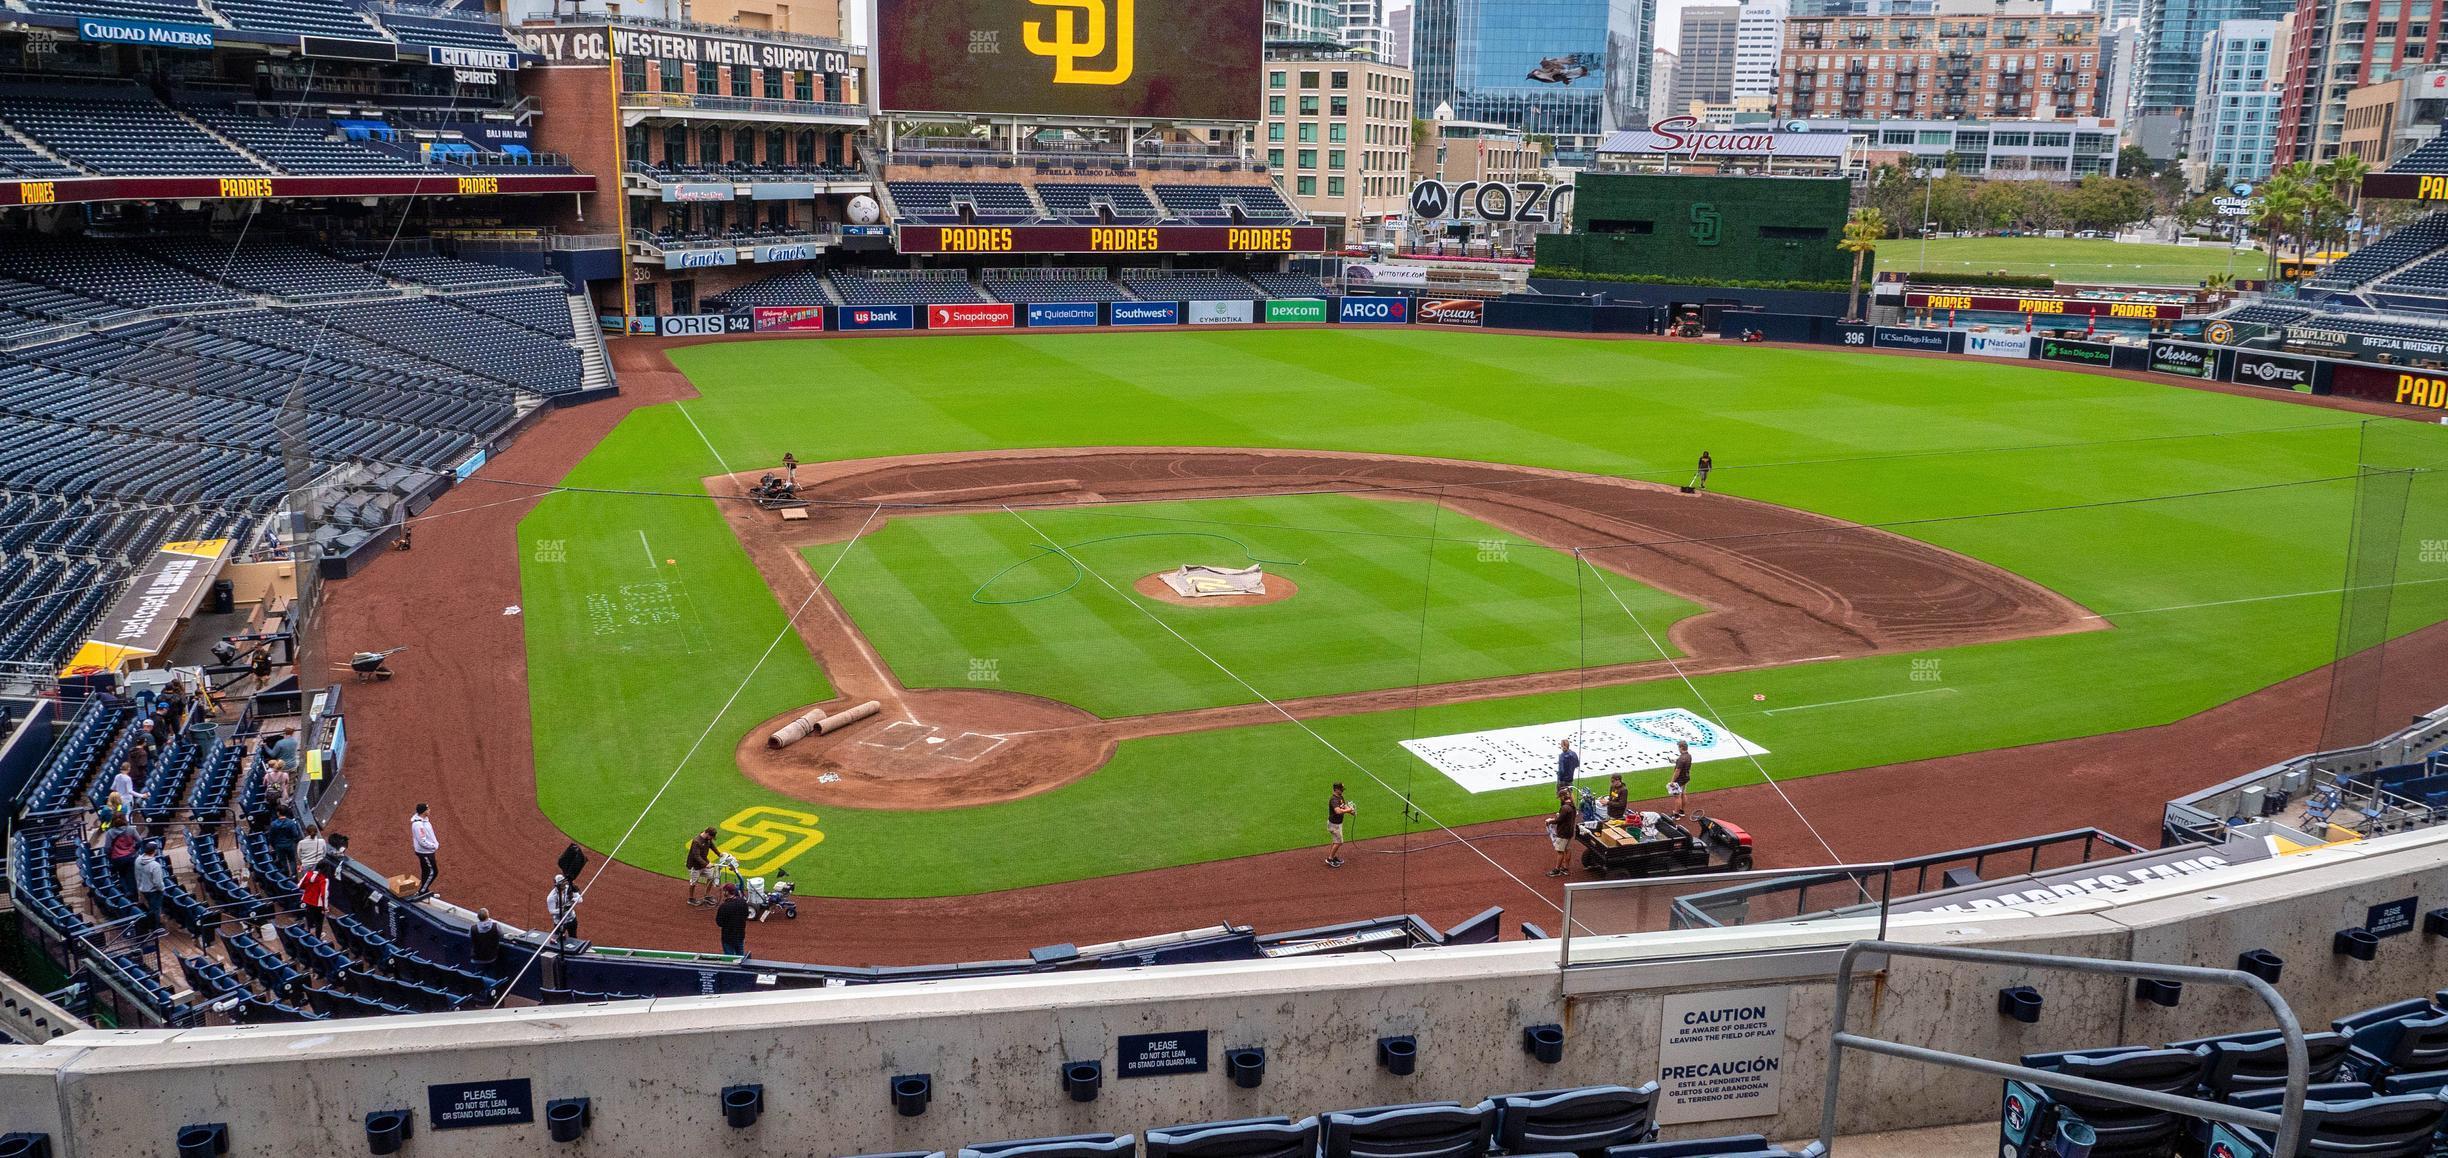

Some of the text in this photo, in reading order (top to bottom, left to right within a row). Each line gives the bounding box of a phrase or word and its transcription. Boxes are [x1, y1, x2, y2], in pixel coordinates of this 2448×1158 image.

[440, 49, 509, 68] CUTWATER
[613, 30, 848, 73] WESTERN METAL SUPPLY CO.
[455, 70, 497, 85] SPIRITS
[514, 131, 527, 139] RUM
[1649, 115, 1777, 161] Sycuan
[220, 179, 272, 197] PADRES
[459, 177, 498, 193] PADRES
[20, 182, 55, 203] PADRES
[1452, 181, 1574, 222] razr
[941, 228, 1013, 251] PADRES
[1091, 228, 1158, 250] PADRES
[1228, 228, 1291, 250] PADRES
[680, 250, 725, 268] Canel's
[767, 245, 806, 262] Canel's
[634, 267, 650, 280] 336
[1927, 295, 1971, 309] PADRES
[2019, 300, 2064, 313] PADRES
[855, 311, 897, 322] us bank
[953, 311, 1008, 322] Snapdragon
[1044, 310, 1094, 319] QuidelOrtho
[1115, 308, 1166, 319] Southwest
[1343, 303, 1388, 317] ARCO
[1421, 301, 1476, 324] Sycuan
[2110, 304, 2157, 318] PADRES
[665, 317, 722, 334] ORIS
[729, 317, 750, 331] 342
[1845, 332, 1864, 345] 396
[1880, 333, 1942, 344] UC San Diego Health
[2286, 328, 2348, 344] TEMPLETON
[1988, 339, 2026, 348] National
[2403, 341, 2444, 353] WHISKEY
[2059, 347, 2110, 360] San Diego Zoo
[2155, 345, 2202, 363] Chosen
[132, 595, 170, 618] petco
[116, 618, 153, 640] park
[1684, 1006, 1766, 1025] CAUTION
[1692, 1026, 1719, 1034] AWARE
[1734, 1022, 1768, 1031] OBJECTS
[1670, 1036, 1703, 1044] LEAVING
[1721, 1032, 1743, 1040] FIELD
[1757, 1029, 1776, 1037] PLAY
[1148, 1040, 1177, 1051] PLEASE
[1161, 1051, 1170, 1059] SIT,
[1137, 1061, 1155, 1069] STAND
[1662, 1056, 1779, 1080] PRECAUCIÓN
[1709, 1077, 1749, 1085] PENDIENTE
[463, 1089, 497, 1101] PLEASE
[1669, 1089, 1702, 1097] OBJETOS
[1721, 1082, 1769, 1093] ABANDONAN
[1688, 1095, 1722, 1103] TERRENO
[1735, 1091, 1759, 1099] JUEGO
[479, 1101, 490, 1109] SIT,
[491, 1100, 507, 1108] LEAN
[485, 1109, 507, 1117] GUARD
[507, 1107, 521, 1115] RAIL
